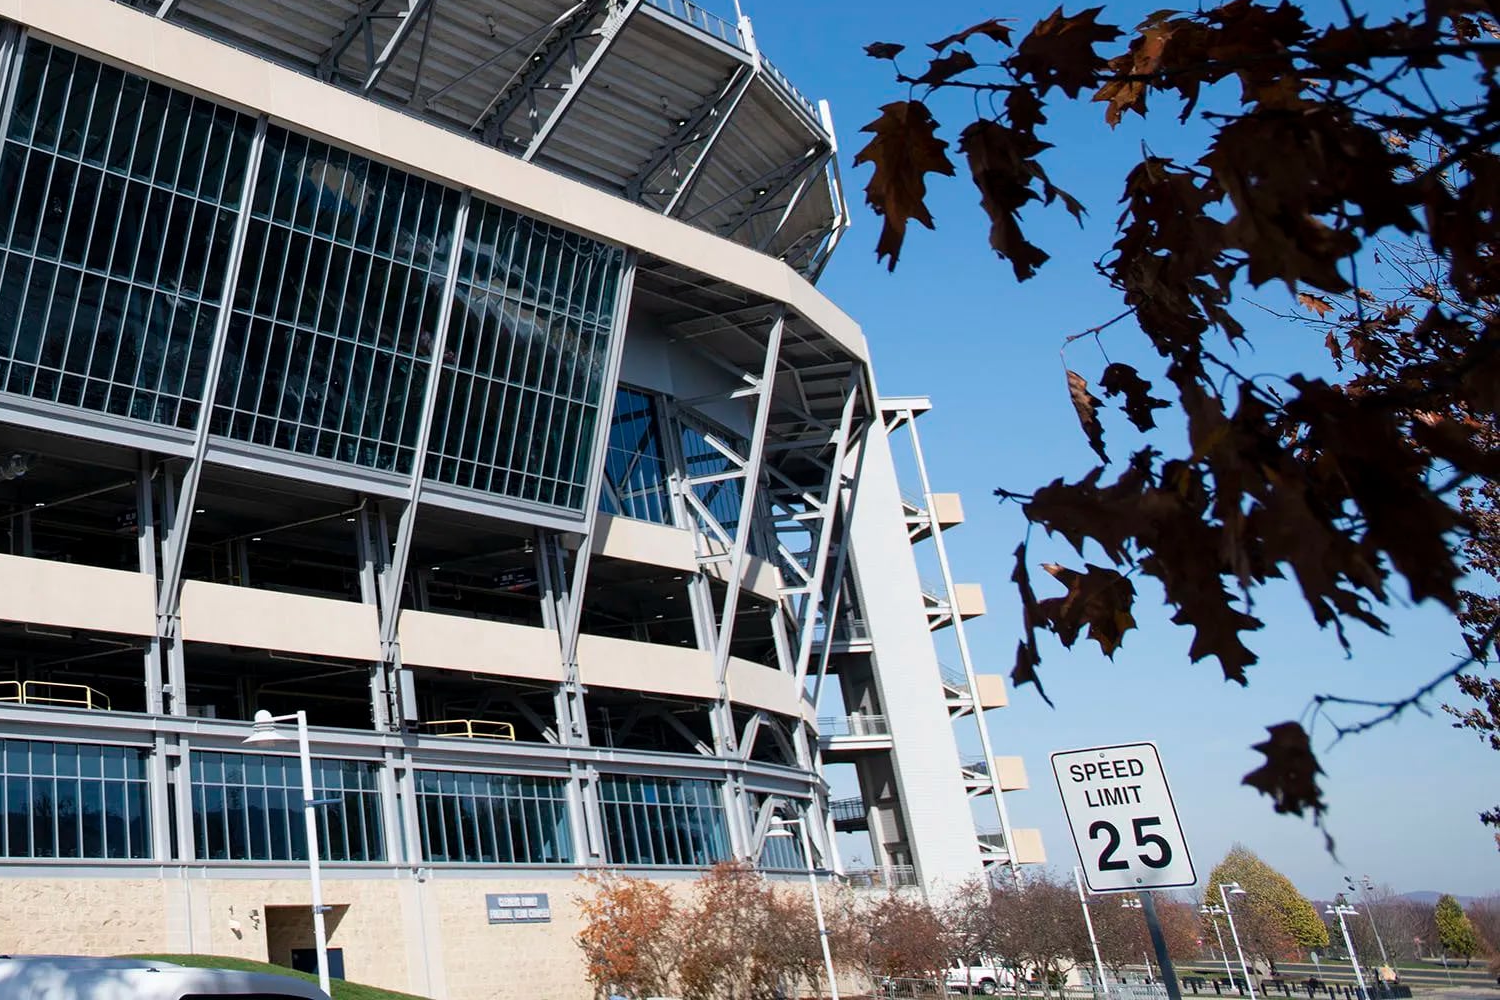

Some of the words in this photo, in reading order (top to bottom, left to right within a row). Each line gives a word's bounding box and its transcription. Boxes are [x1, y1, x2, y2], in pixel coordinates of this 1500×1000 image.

[1070, 759, 1144, 783] SPEED
[1084, 785, 1142, 807] LIMIT
[1088, 816, 1172, 872] 25
